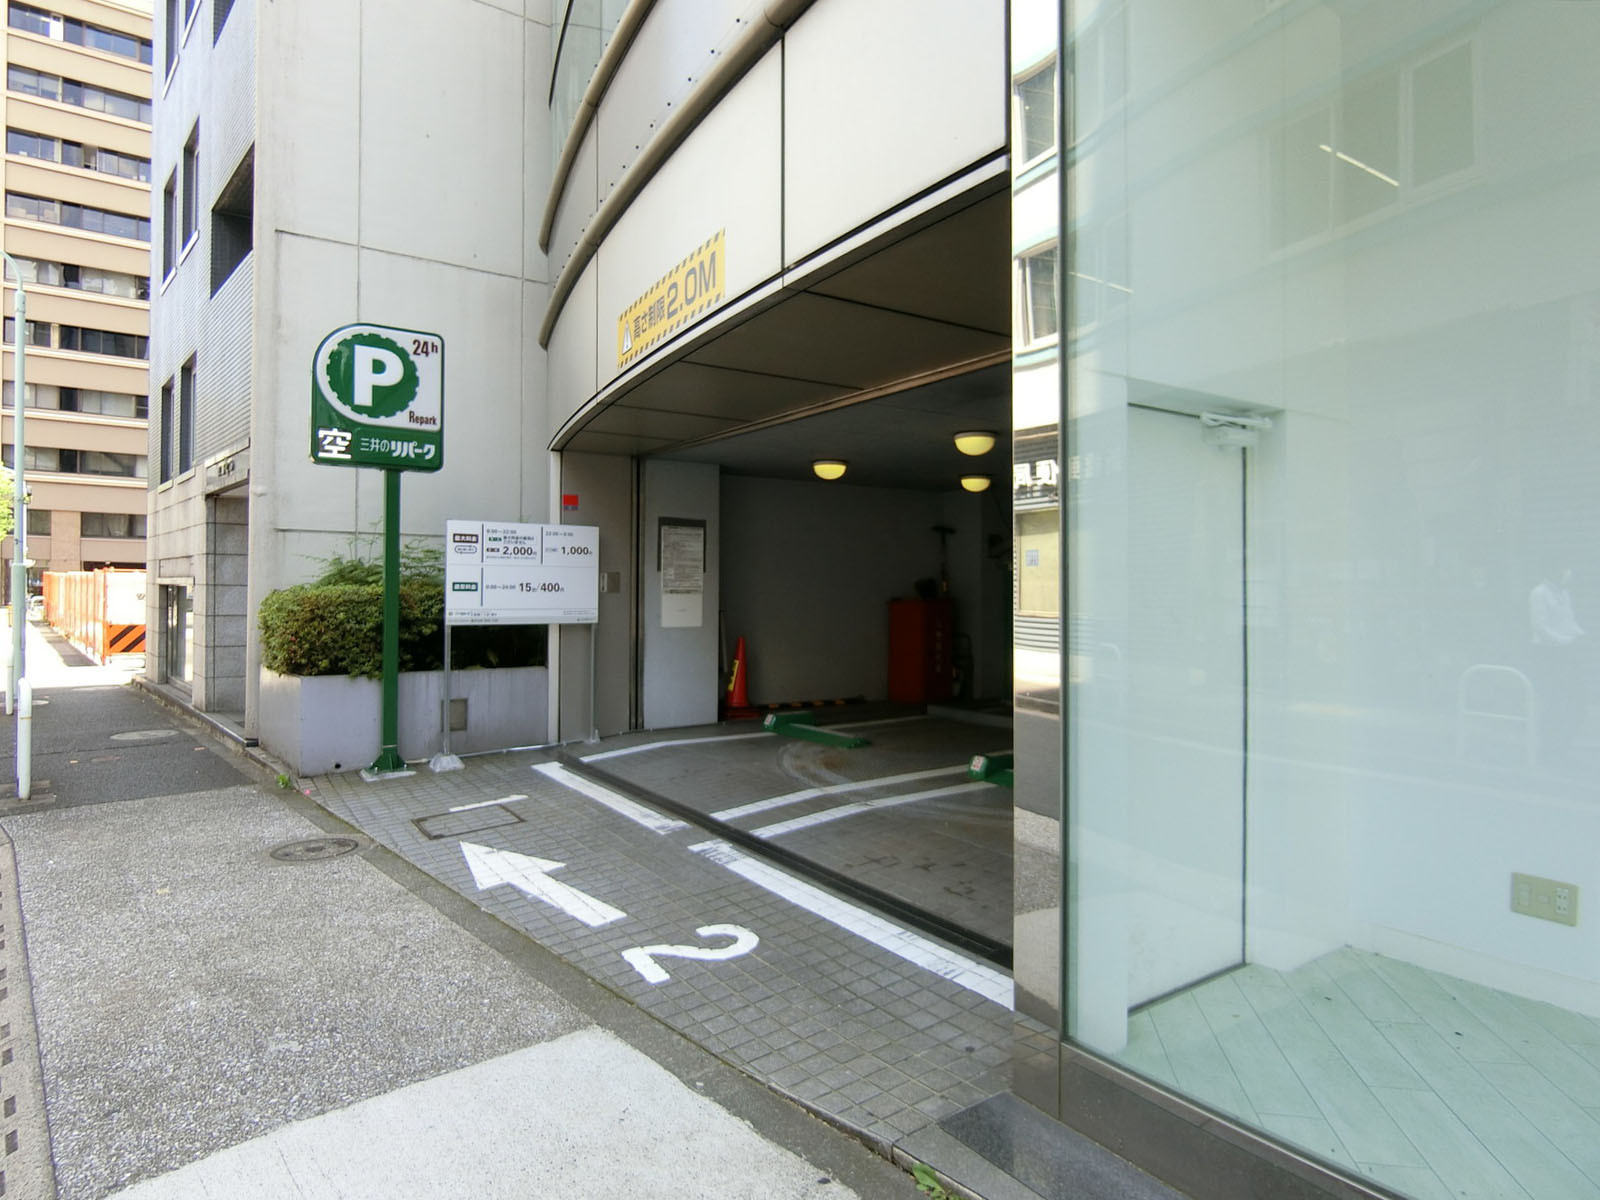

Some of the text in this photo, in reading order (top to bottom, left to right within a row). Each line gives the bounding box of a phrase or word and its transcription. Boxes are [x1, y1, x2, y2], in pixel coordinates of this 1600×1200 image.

[412, 339, 438, 358] 24h
[353, 343, 405, 407] P
[408, 411, 437, 426] Repark
[317, 427, 353, 460] 空
[360, 437, 436, 460] 三井のリパーク
[621, 923, 759, 985] 2
